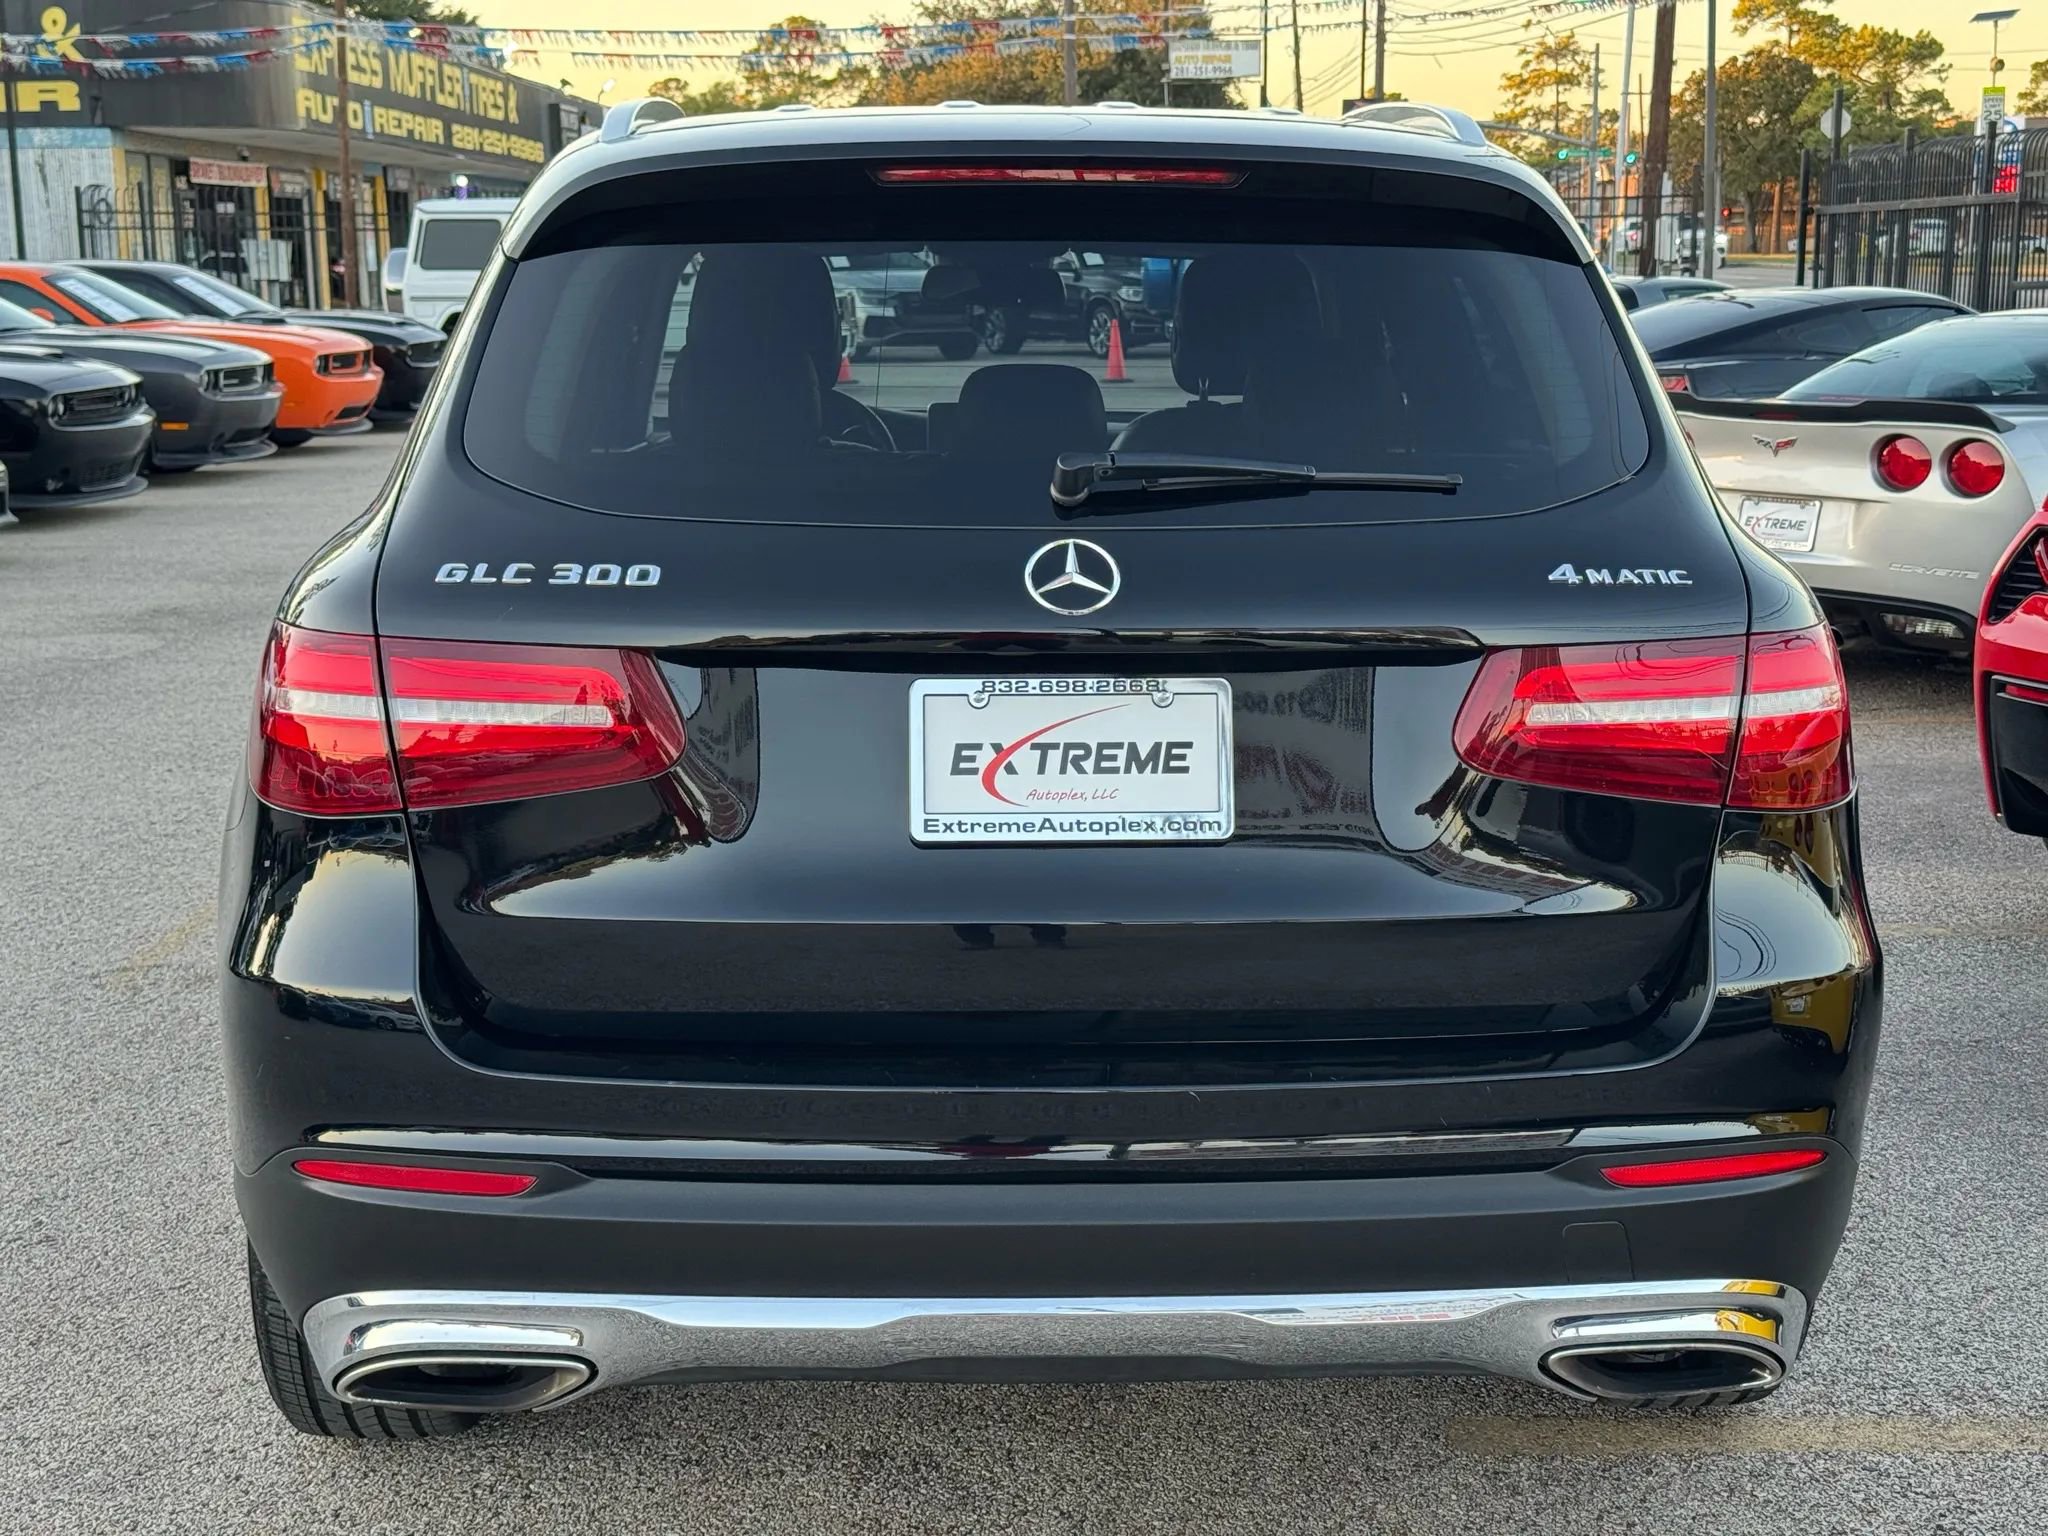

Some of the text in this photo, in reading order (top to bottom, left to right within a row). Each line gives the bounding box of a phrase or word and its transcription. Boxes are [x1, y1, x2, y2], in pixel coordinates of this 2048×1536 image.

[36, 6, 86, 62] &
[293, 15, 519, 124] EXPESS MUFFLER TIRES &
[1175, 55, 1199, 64] AUTO
[374, 106, 445, 145] REPAIR
[1984, 110, 2002, 120] 25
[1745, 516, 1807, 531] EXTREME
[434, 563, 661, 587] GLC 300
[1548, 563, 1693, 585] 4MATIC
[981, 679, 1160, 693] 832-698-2668
[949, 741, 1194, 776] EXTREME
[1026, 788, 1119, 803] Autoplex, LLC
[923, 815, 1222, 836] ExtremeAutoplex.com
